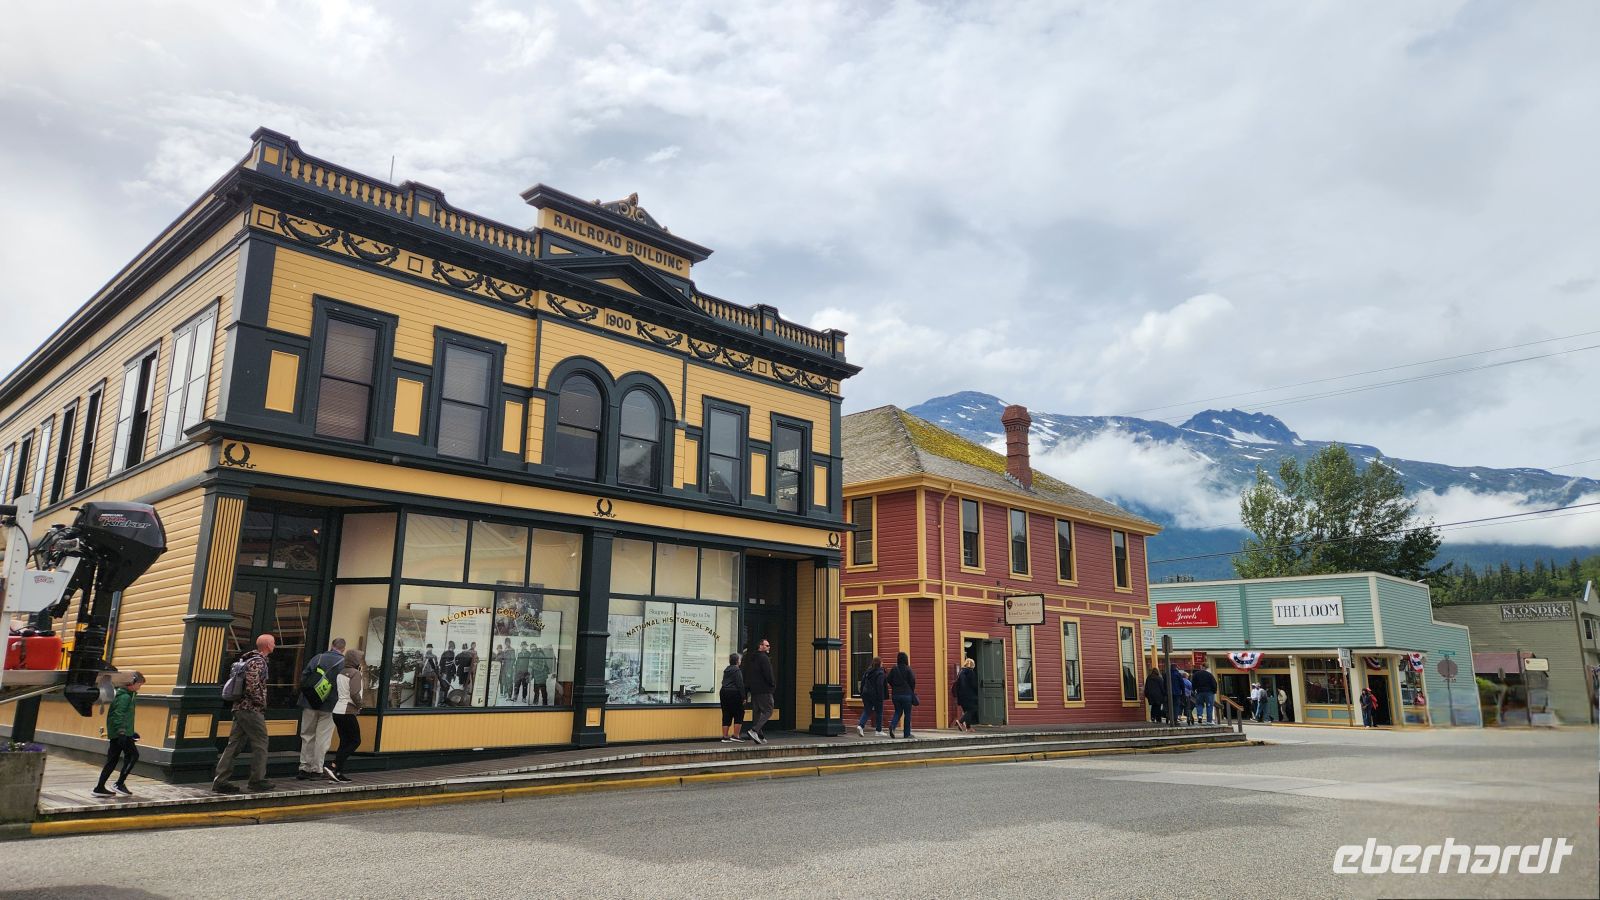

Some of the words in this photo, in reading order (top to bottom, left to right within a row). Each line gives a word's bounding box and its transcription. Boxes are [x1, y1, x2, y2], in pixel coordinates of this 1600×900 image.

[553, 213, 622, 249] RAILROAD
[605, 312, 632, 331] 1900
[440, 607, 492, 626] KLONDIKE
[496, 607, 521, 619] GOLD
[1275, 605, 1300, 618] THE
[1302, 603, 1340, 617] LOOM
[1502, 605, 1570, 615] KLONDIKE
[626, 618, 660, 638] NATIONAL
[704, 626, 721, 641] PARK
